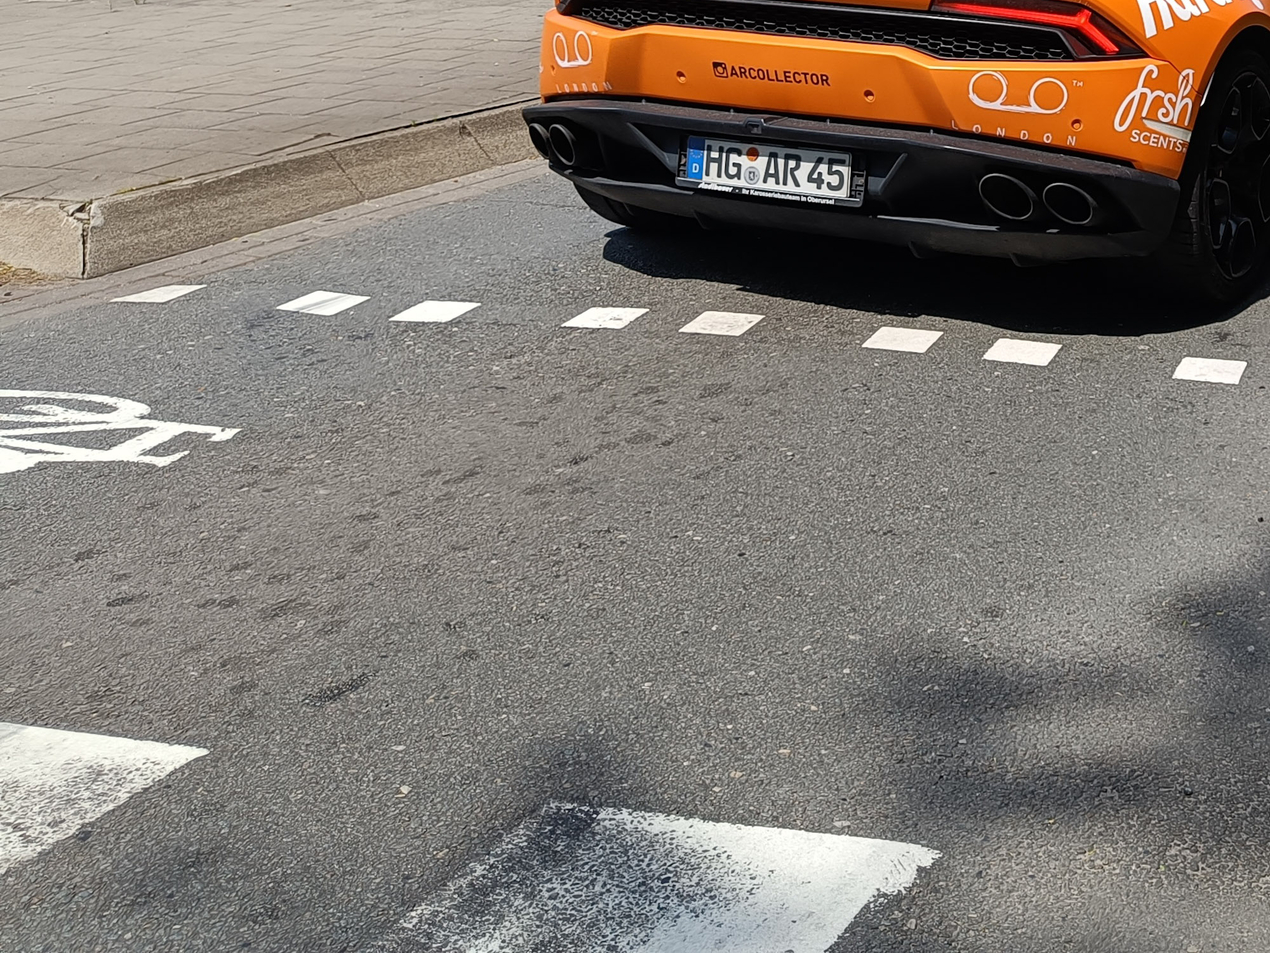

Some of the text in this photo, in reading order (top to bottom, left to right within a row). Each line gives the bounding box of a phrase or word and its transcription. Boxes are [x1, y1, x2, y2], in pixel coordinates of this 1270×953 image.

[555, 81, 612, 94] LONDON
[730, 65, 831, 87] ARCOLLECTOR
[1113, 64, 1196, 132] frsh
[951, 119, 1076, 146] LONDON
[1130, 129, 1184, 153] SCENTS
[692, 144, 846, 192] D HG AR 45
[807, 196, 835, 205] Oberursel
